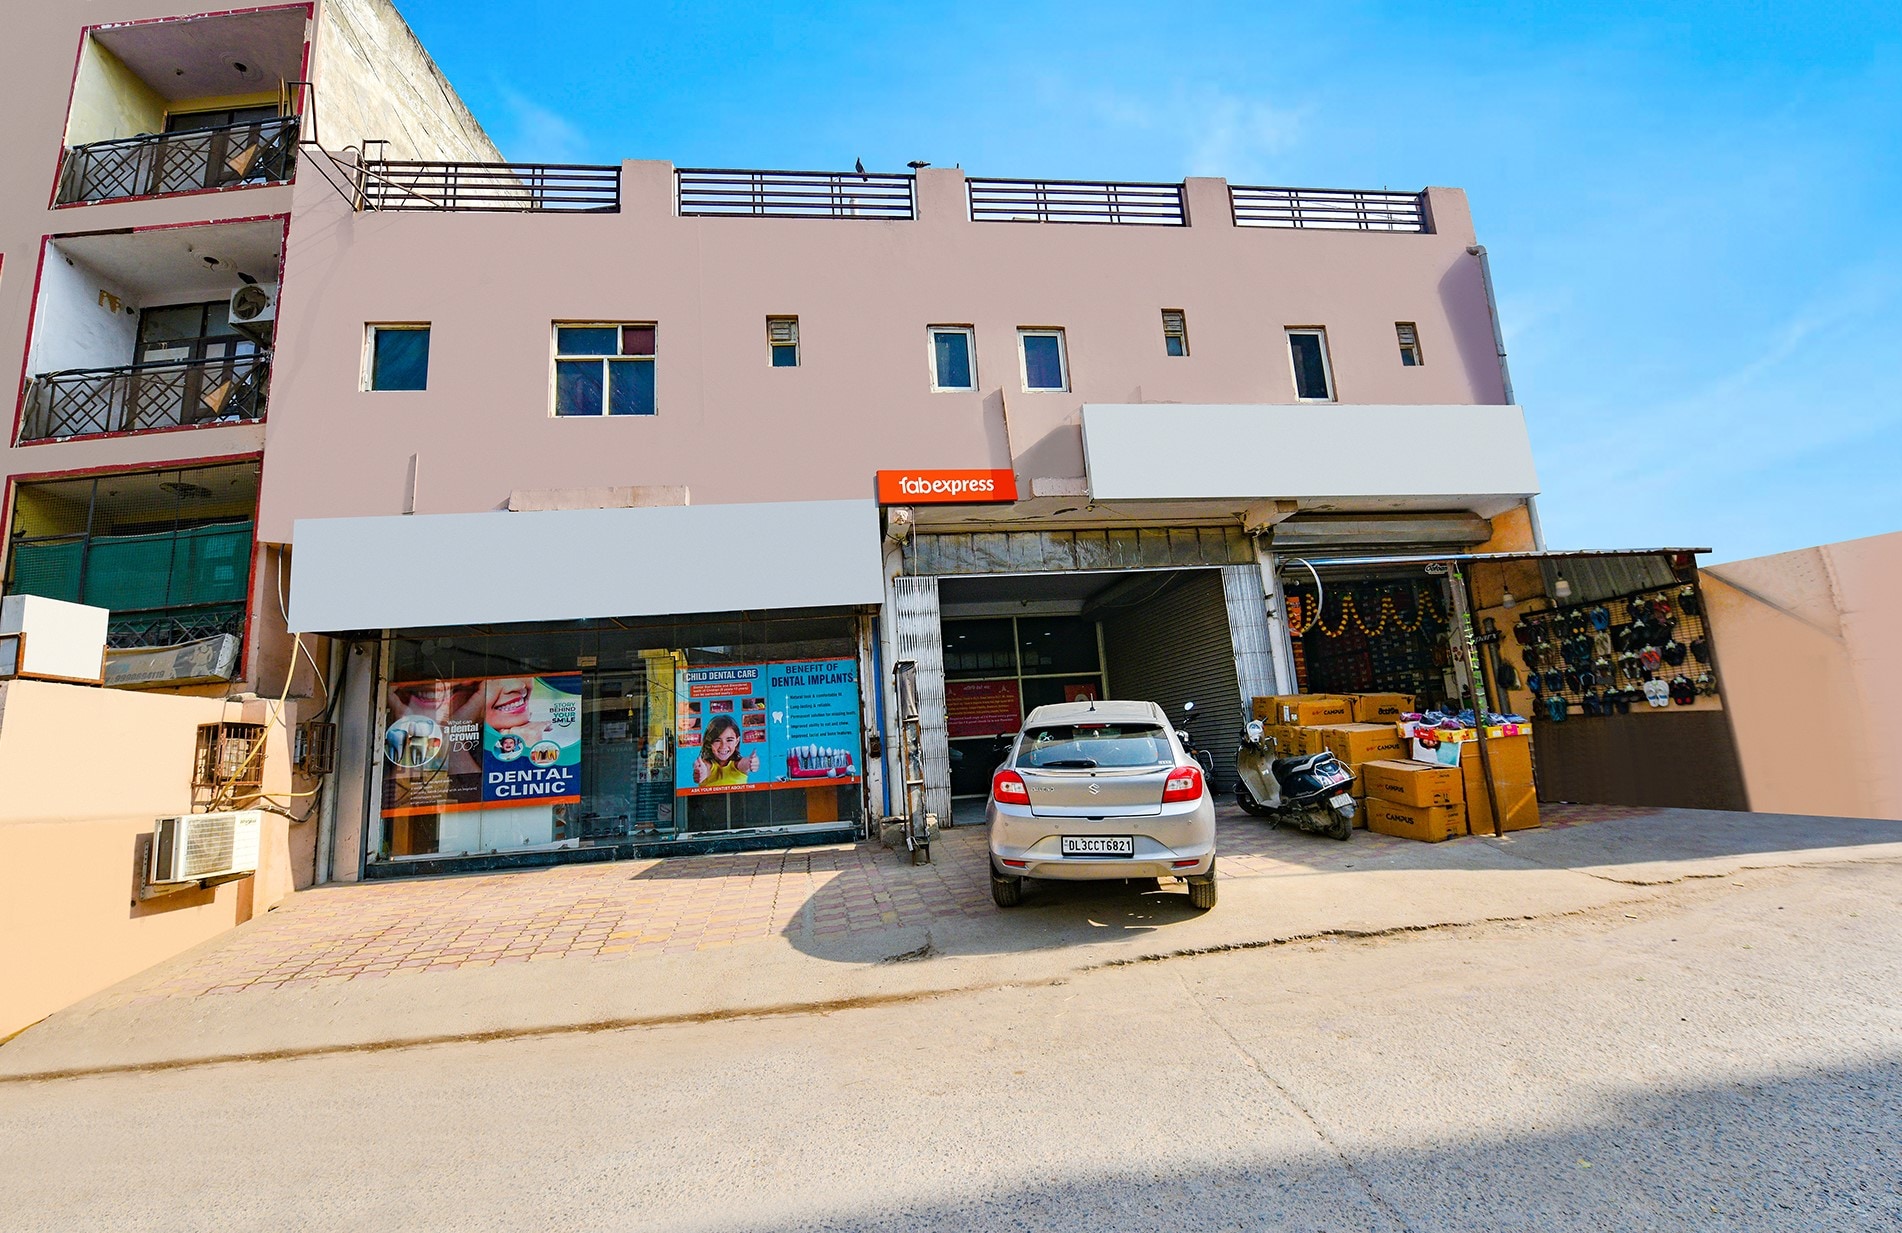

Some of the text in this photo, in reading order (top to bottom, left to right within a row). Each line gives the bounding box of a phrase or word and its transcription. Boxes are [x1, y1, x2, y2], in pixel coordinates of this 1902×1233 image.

[898, 476, 995, 496] fabexpress
[785, 663, 839, 674] BENEFIT OF
[686, 669, 757, 681] CHILD DENTAL CARE
[771, 672, 854, 688] DENTAL IMPLANTS
[443, 723, 479, 734] a dental
[450, 732, 479, 742] crown
[453, 740, 480, 752] DO?
[1377, 743, 1400, 751] CAMPUS
[488, 767, 573, 784] DENTAL
[495, 781, 566, 797] CLINIC
[1385, 813, 1415, 825] CAMPUS
[1068, 840, 1131, 851] DL3CCT6821
